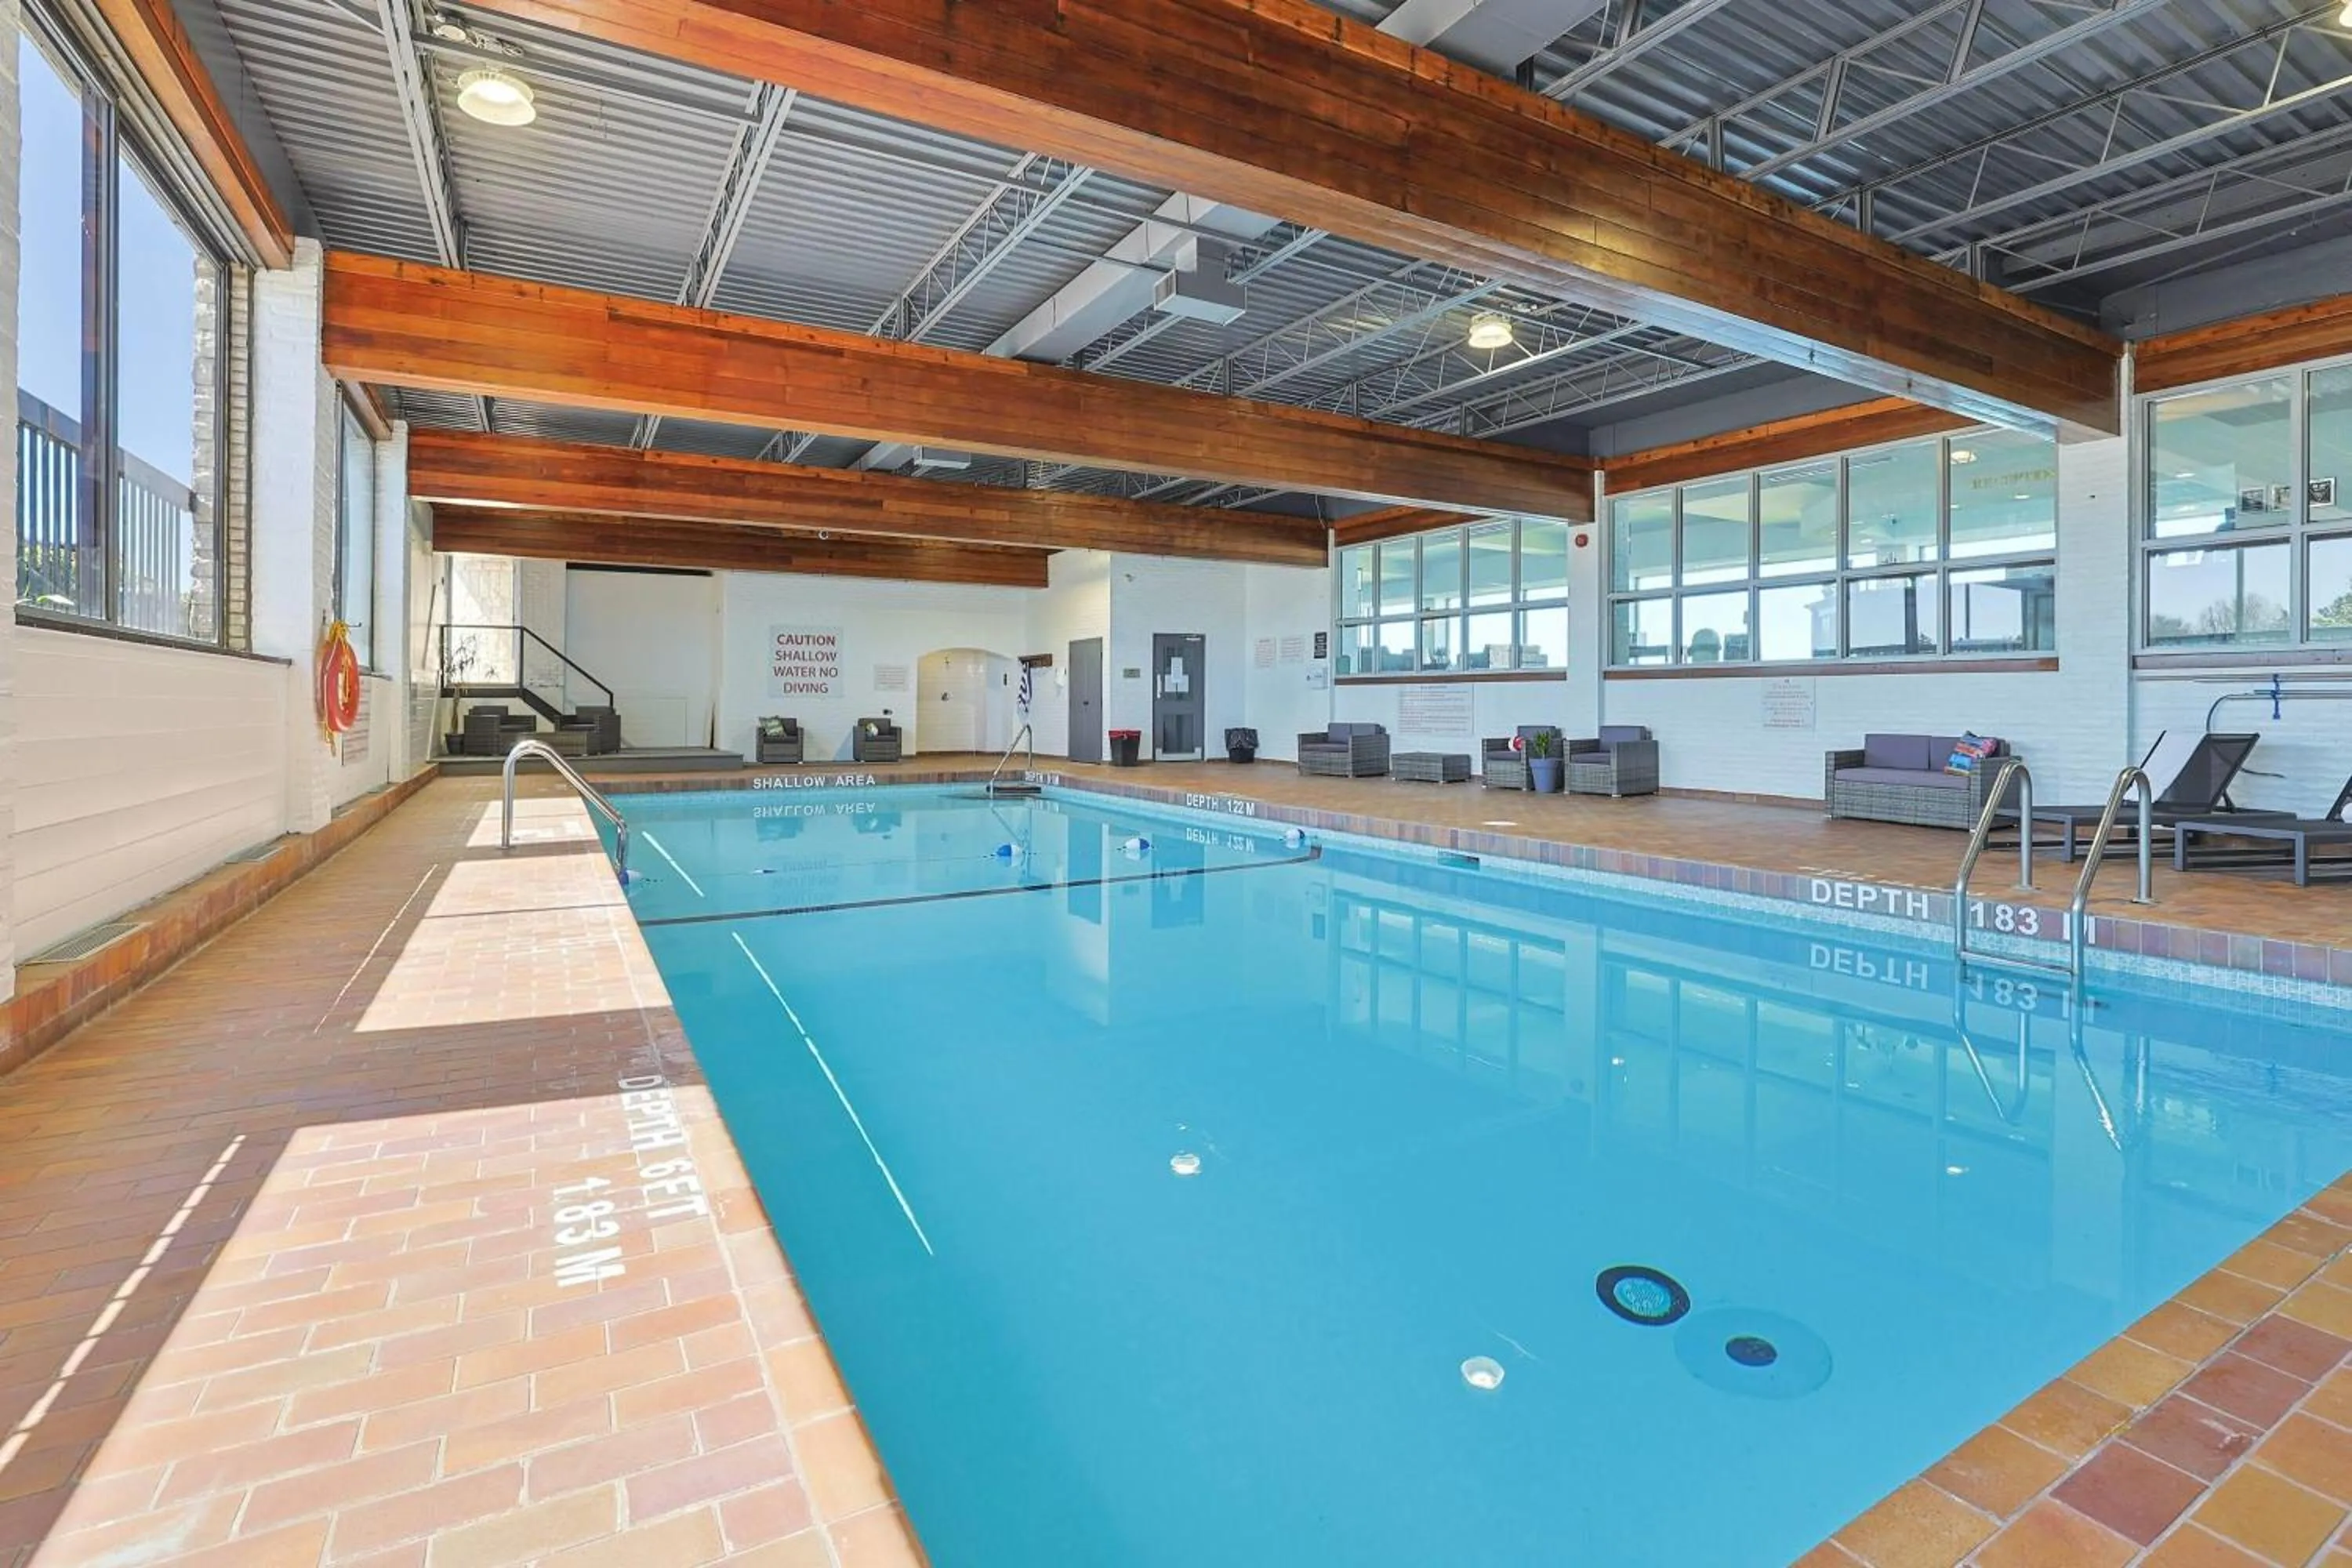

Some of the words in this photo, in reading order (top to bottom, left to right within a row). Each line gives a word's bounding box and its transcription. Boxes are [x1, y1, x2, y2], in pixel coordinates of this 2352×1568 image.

[777, 633, 836, 646] CAUTION
[775, 650, 837, 662] SHALLOW
[773, 666, 816, 677] WATER
[819, 666, 838, 677] NO
[783, 681, 829, 693] DIVING
[753, 775, 826, 789] SHALLOW
[835, 774, 877, 787] AREA
[1186, 793, 1219, 810] DEPTH
[1811, 879, 1929, 920] DEPTH
[1969, 901, 2039, 935] 183
[618, 1074, 688, 1151] DEPTH
